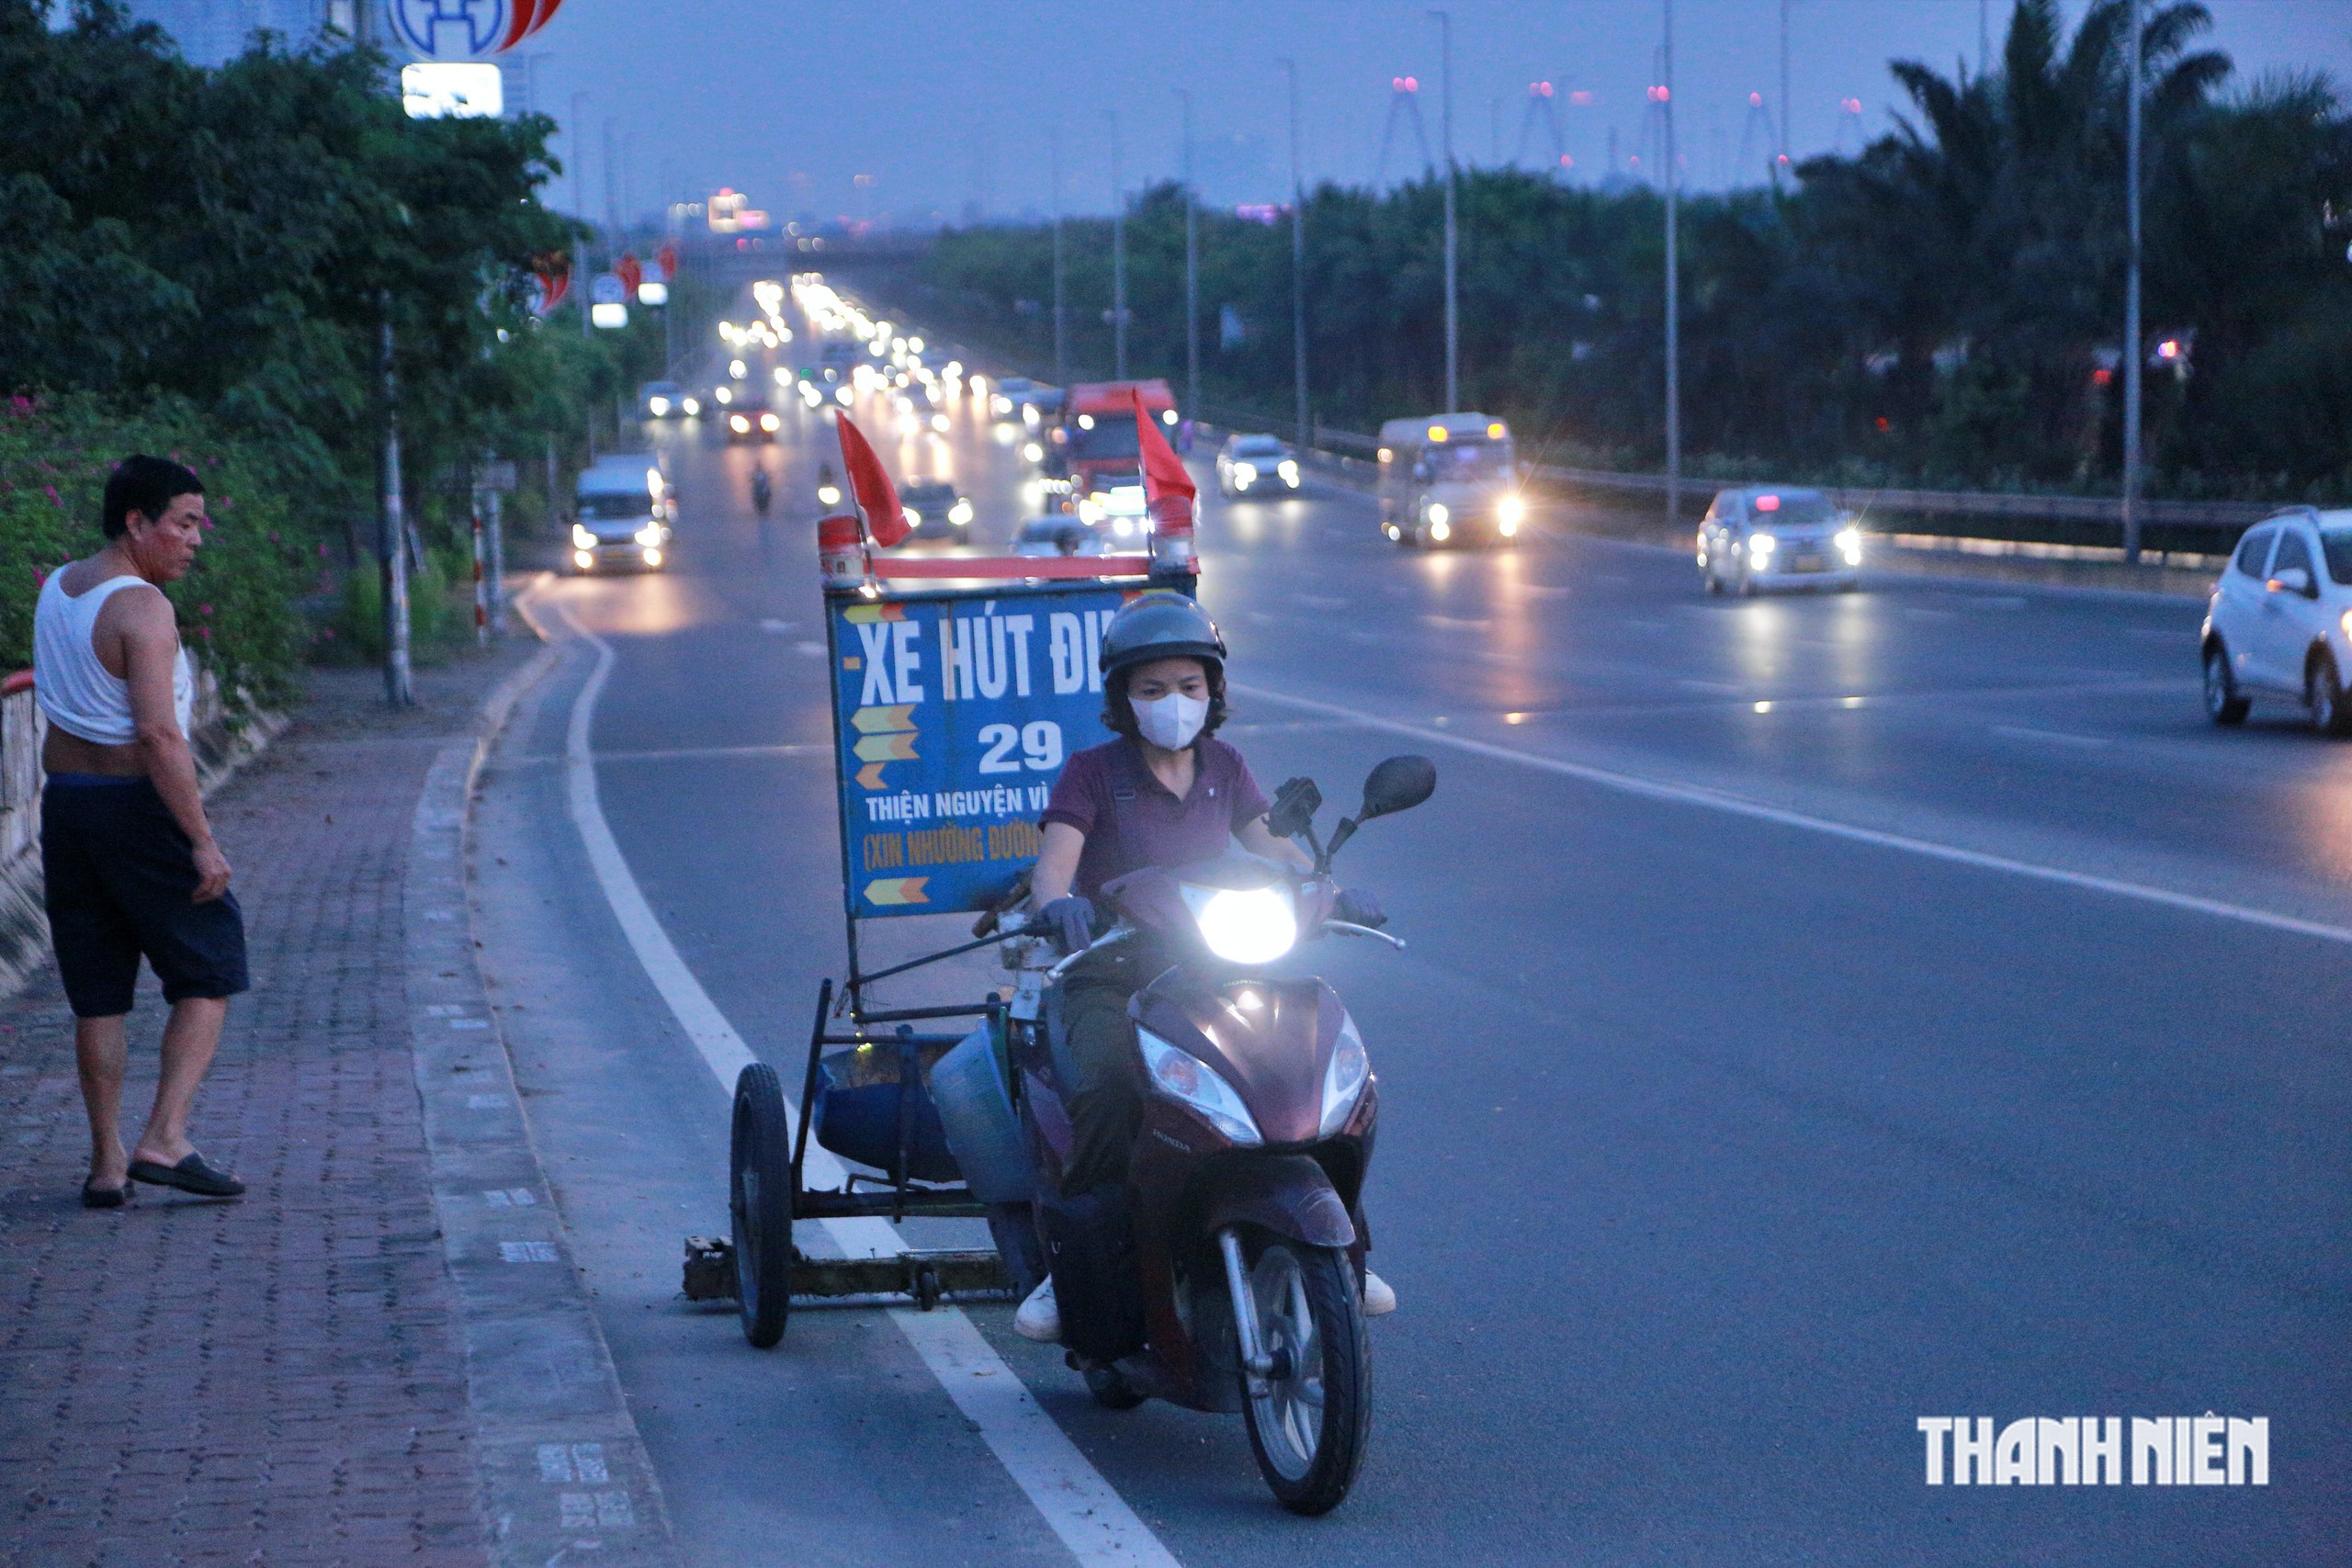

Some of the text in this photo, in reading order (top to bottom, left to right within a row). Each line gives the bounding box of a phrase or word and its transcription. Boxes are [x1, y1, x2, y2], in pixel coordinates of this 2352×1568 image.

[857, 600, 1115, 705] XE HÚT ĐI
[978, 720, 1062, 773] 29
[865, 781, 1048, 824] THIỆN NGUYỆN VÌ
[864, 833, 902, 872] (XIN
[989, 817, 1045, 861] ĐƯỜN
